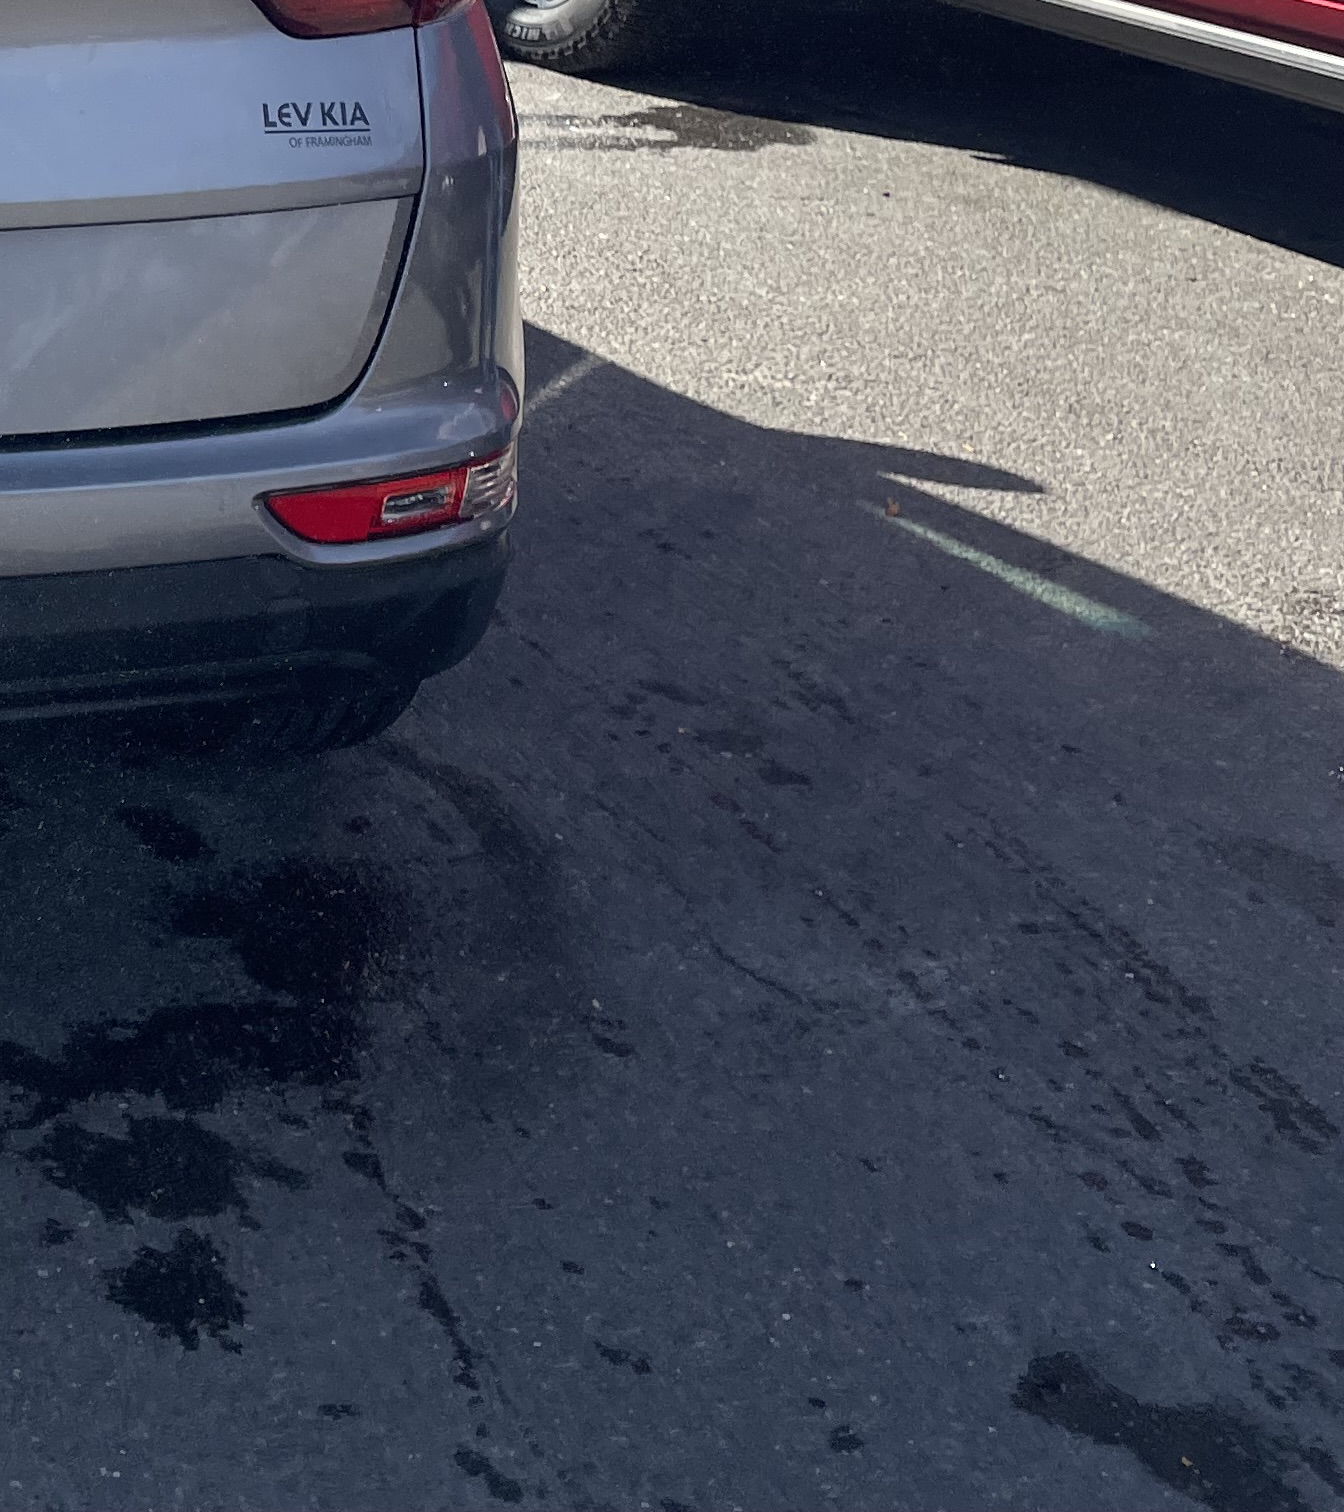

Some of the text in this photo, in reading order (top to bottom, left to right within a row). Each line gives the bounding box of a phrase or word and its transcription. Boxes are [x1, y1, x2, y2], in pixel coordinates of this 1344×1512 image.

[262, 100, 371, 128] LEV KIA
[288, 135, 373, 149] OF FRAMINGHAM
